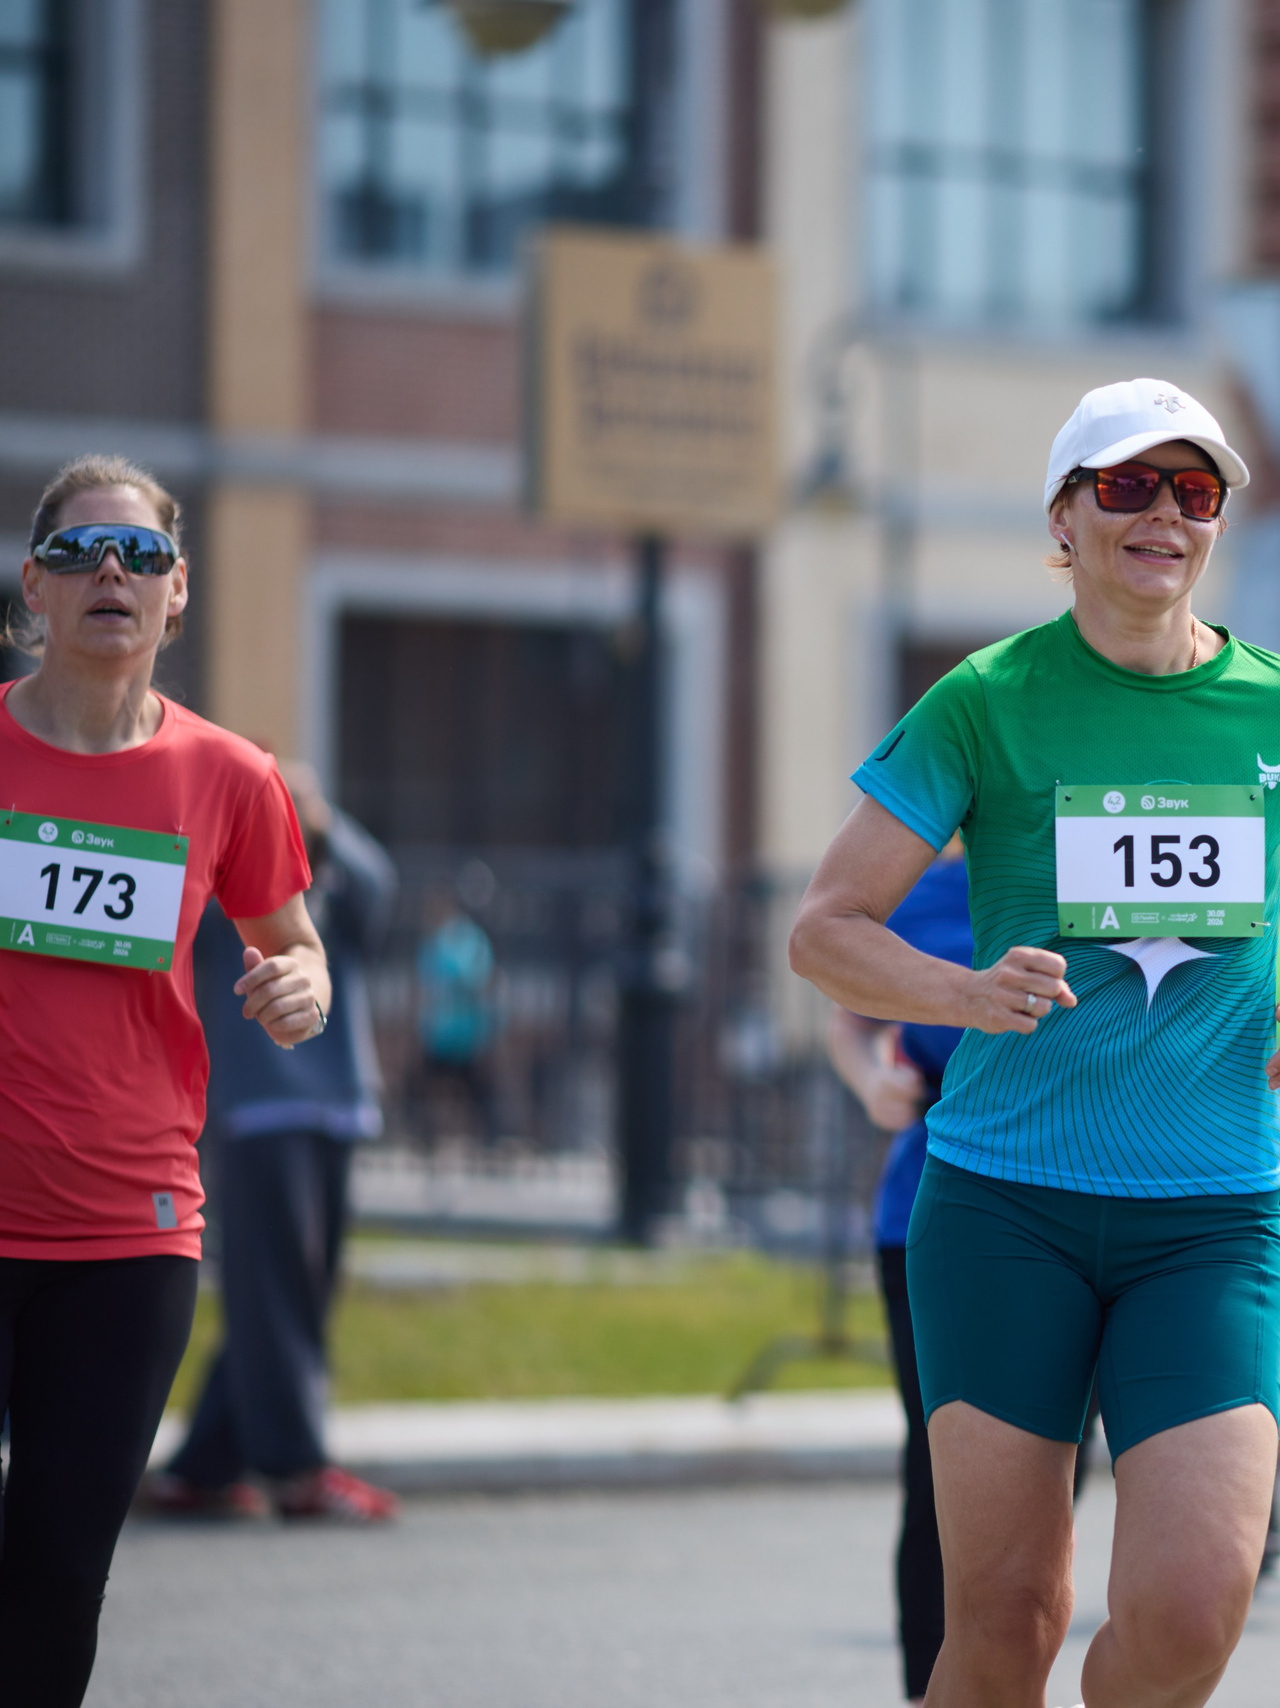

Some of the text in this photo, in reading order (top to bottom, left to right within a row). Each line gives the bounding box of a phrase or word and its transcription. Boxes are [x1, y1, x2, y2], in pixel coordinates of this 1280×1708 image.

[1157, 797, 1189, 811] Звук
[86, 832, 115, 848] Звук
[1113, 834, 1221, 888] 153
[40, 862, 137, 921] 173
[1099, 905, 1121, 930] A
[1206, 909, 1226, 917] 30.05
[1206, 918, 1224, 926] 2026
[16, 922, 35, 947] A
